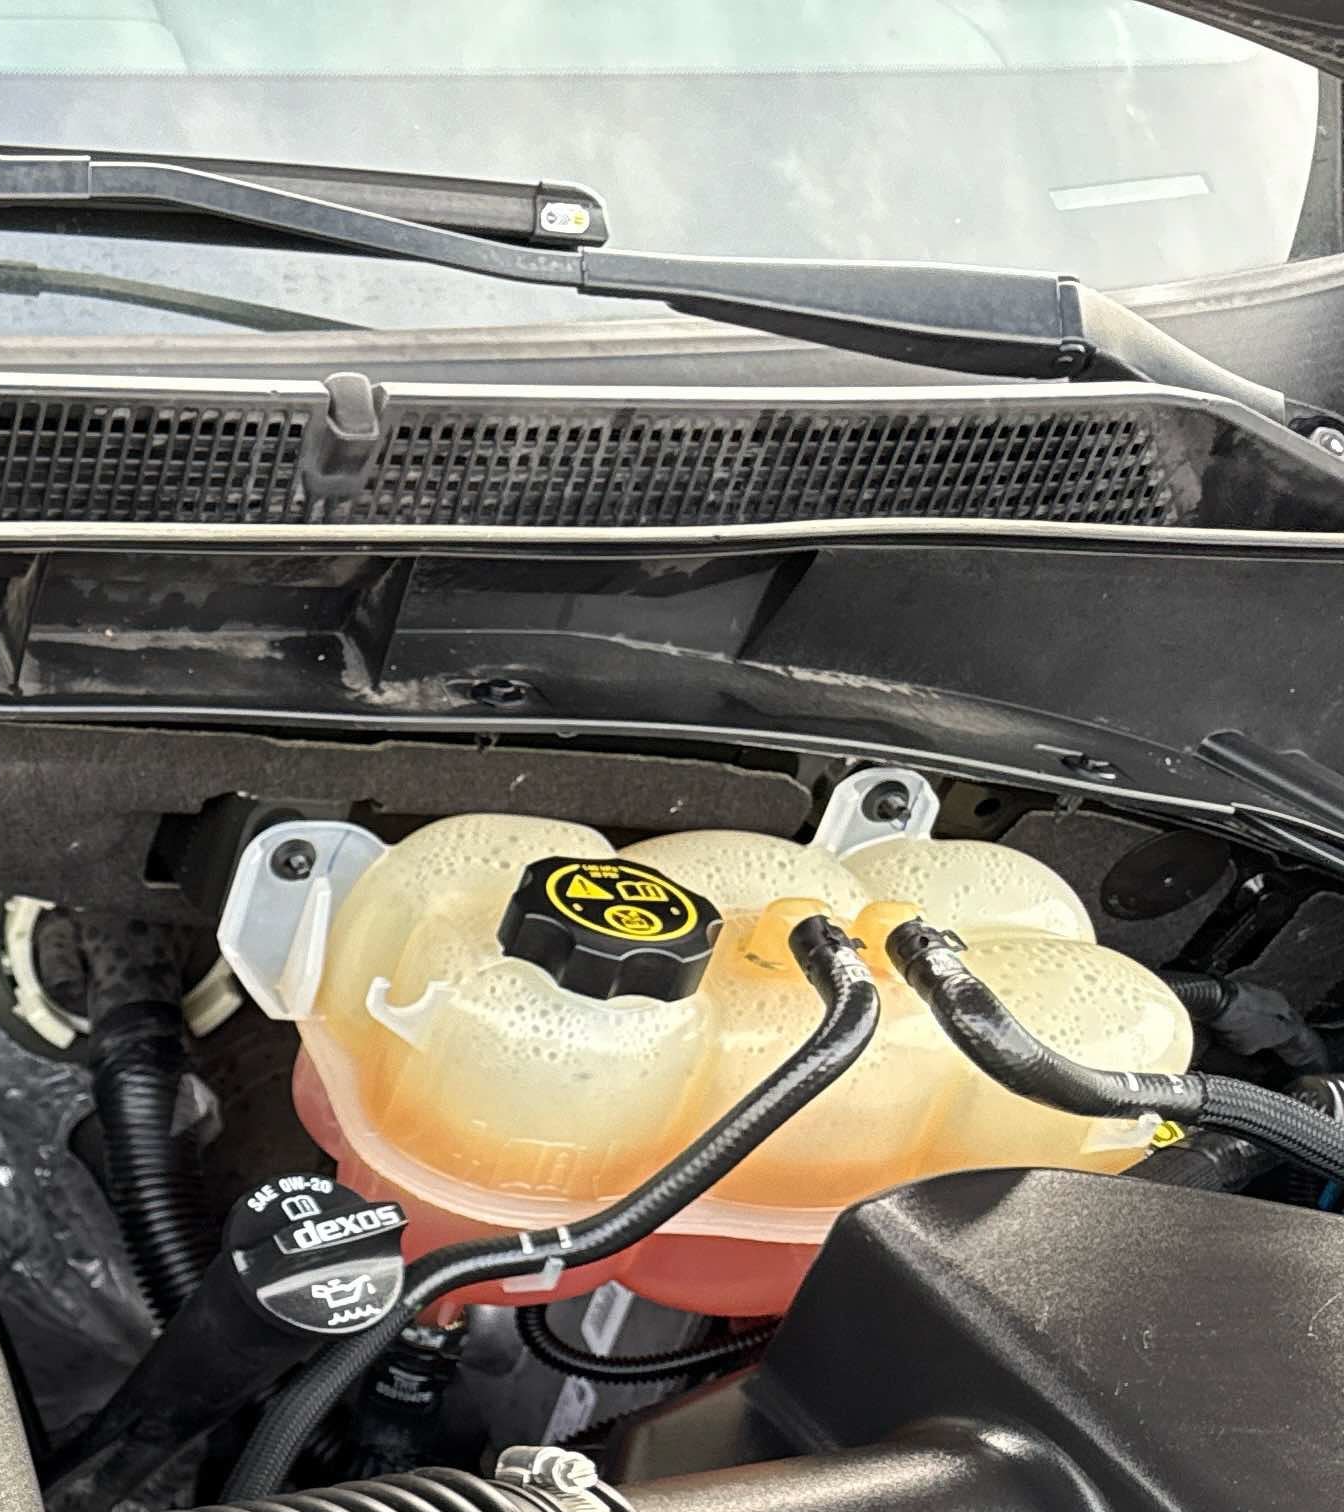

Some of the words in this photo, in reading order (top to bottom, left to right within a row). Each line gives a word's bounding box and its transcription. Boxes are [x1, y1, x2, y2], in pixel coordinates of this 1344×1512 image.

[247, 1184, 279, 1213] SAE
[278, 1175, 334, 1194] 0W-20
[293, 1204, 401, 1249] dexos
